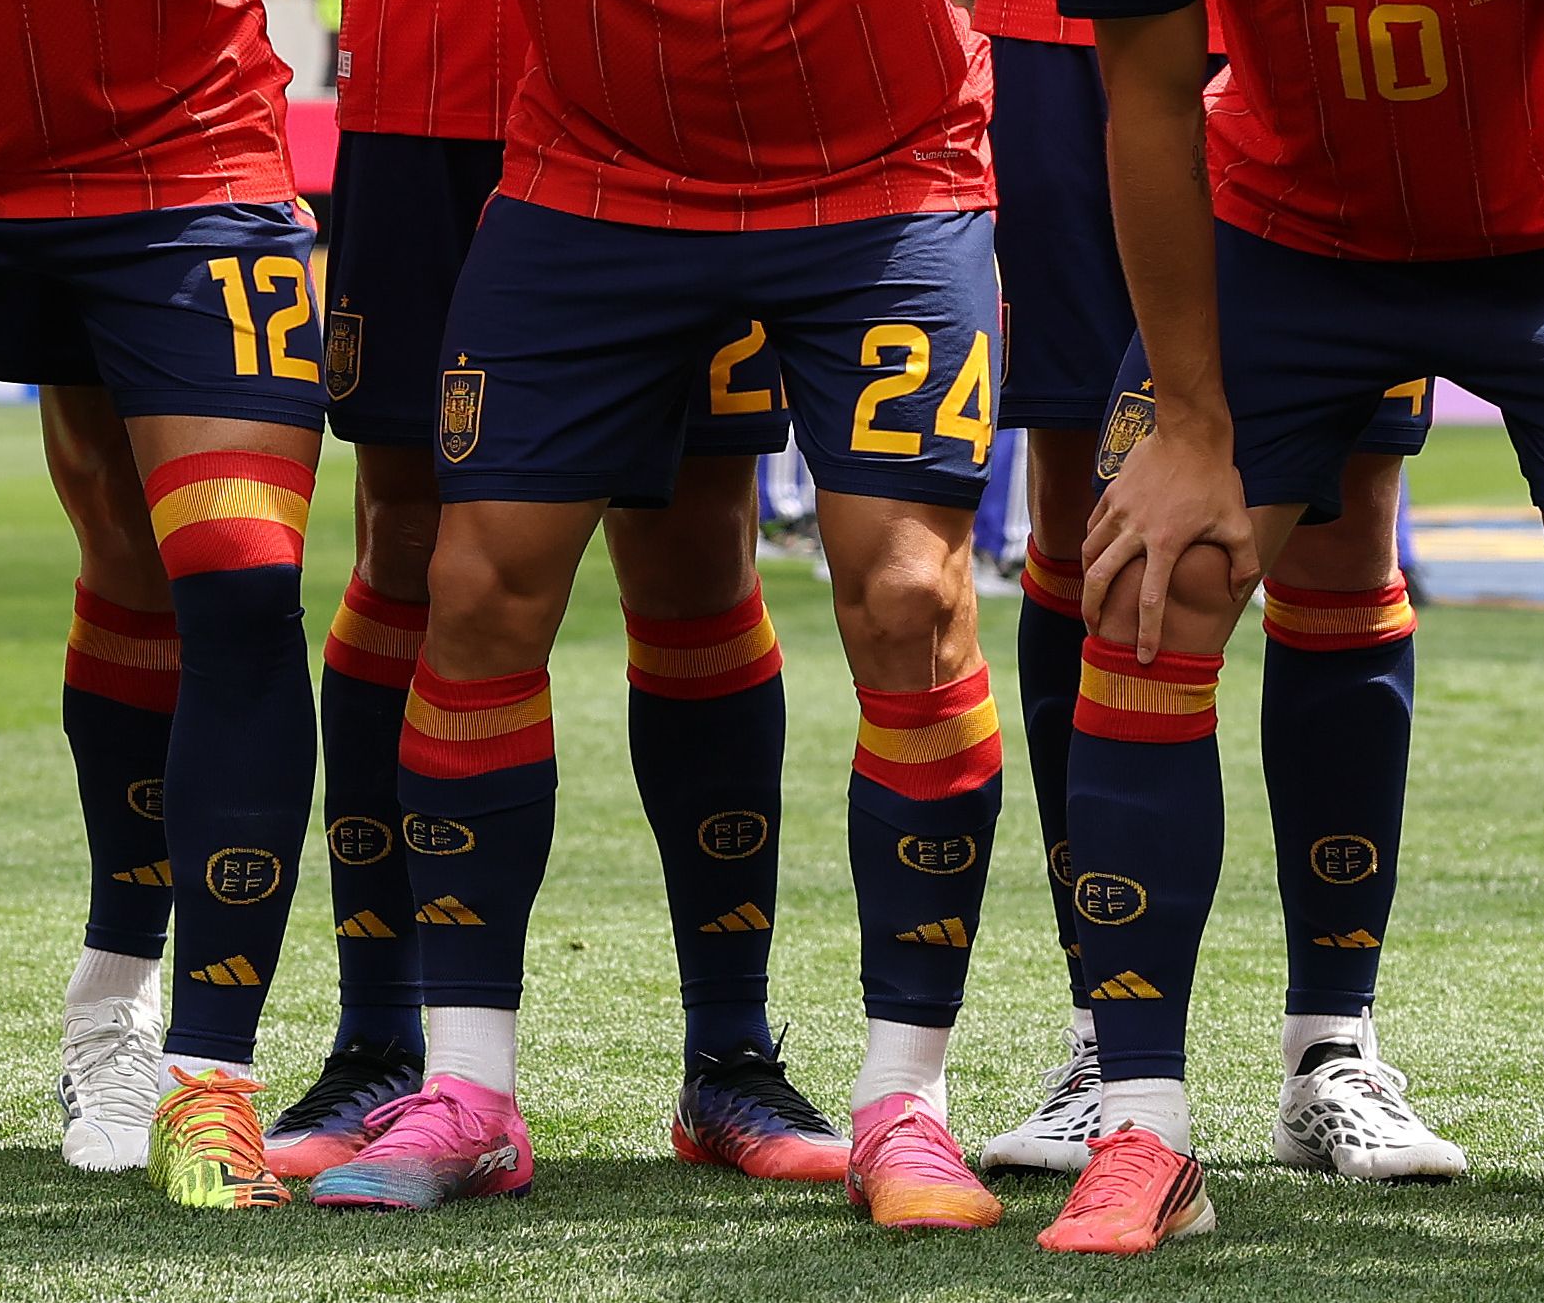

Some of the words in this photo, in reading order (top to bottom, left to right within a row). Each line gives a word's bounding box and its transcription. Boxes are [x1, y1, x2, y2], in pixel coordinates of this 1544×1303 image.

[1325, 3, 1448, 101] 10
[208, 256, 321, 384] 12
[709, 319, 788, 416] 2
[850, 323, 995, 466] 24
